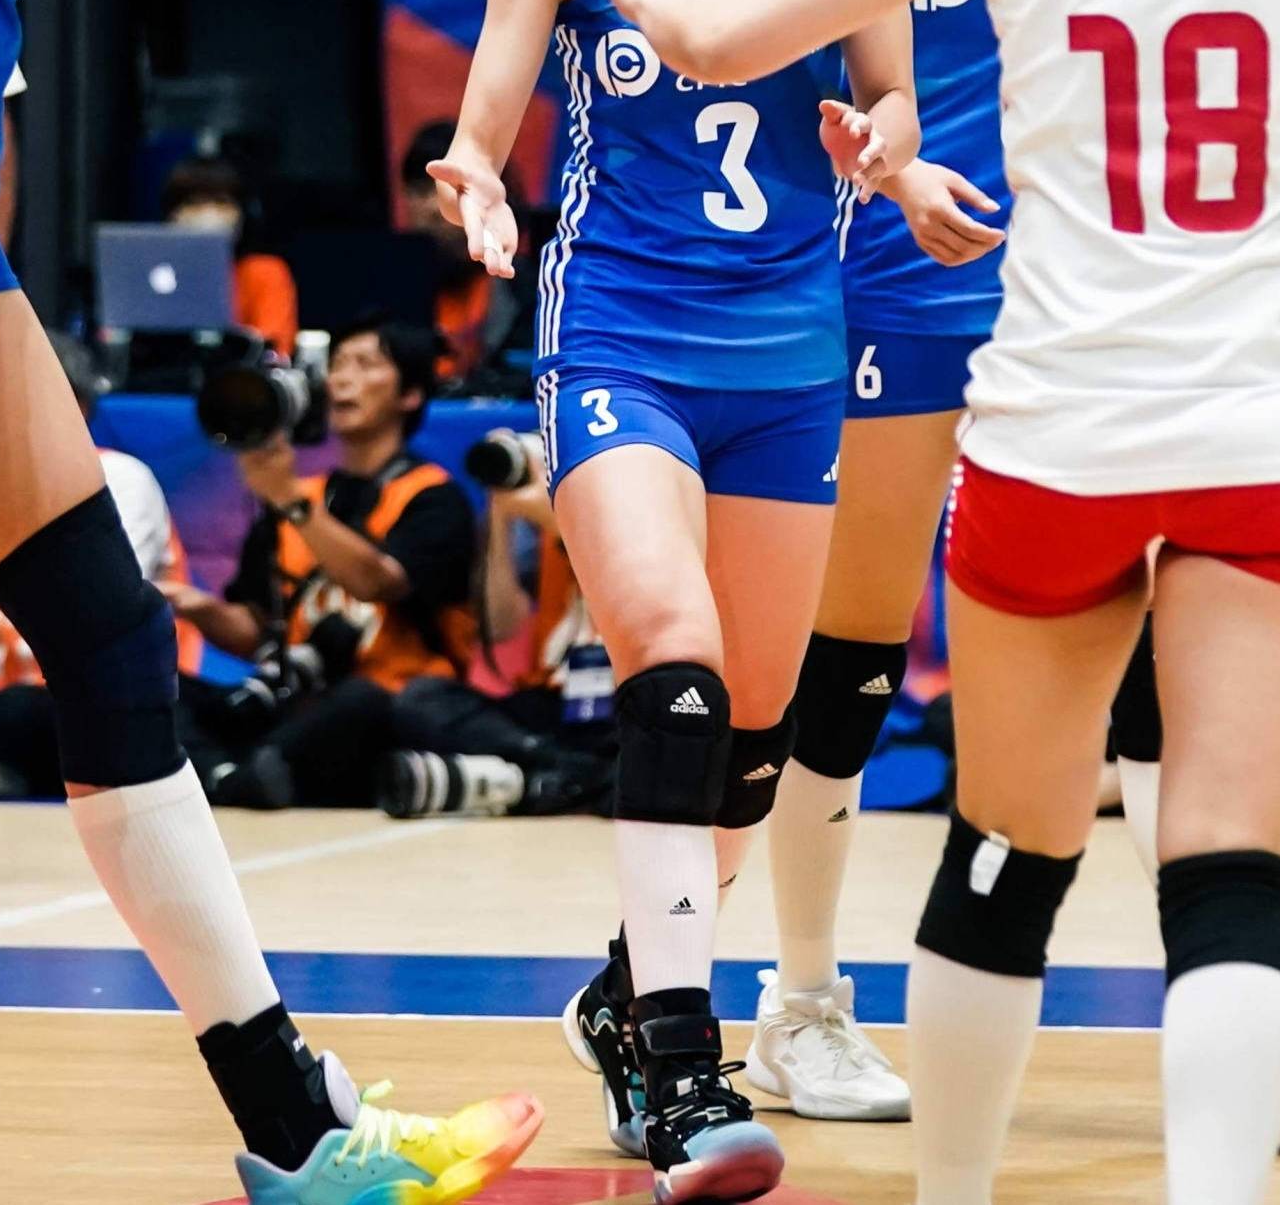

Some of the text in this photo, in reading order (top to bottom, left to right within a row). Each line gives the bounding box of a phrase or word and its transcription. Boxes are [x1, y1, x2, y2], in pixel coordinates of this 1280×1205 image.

[1067, 11, 1270, 234] 18
[694, 101, 769, 232] 3
[855, 345, 883, 399] 6
[580, 389, 619, 436] 3
[670, 703, 710, 715] adidas
